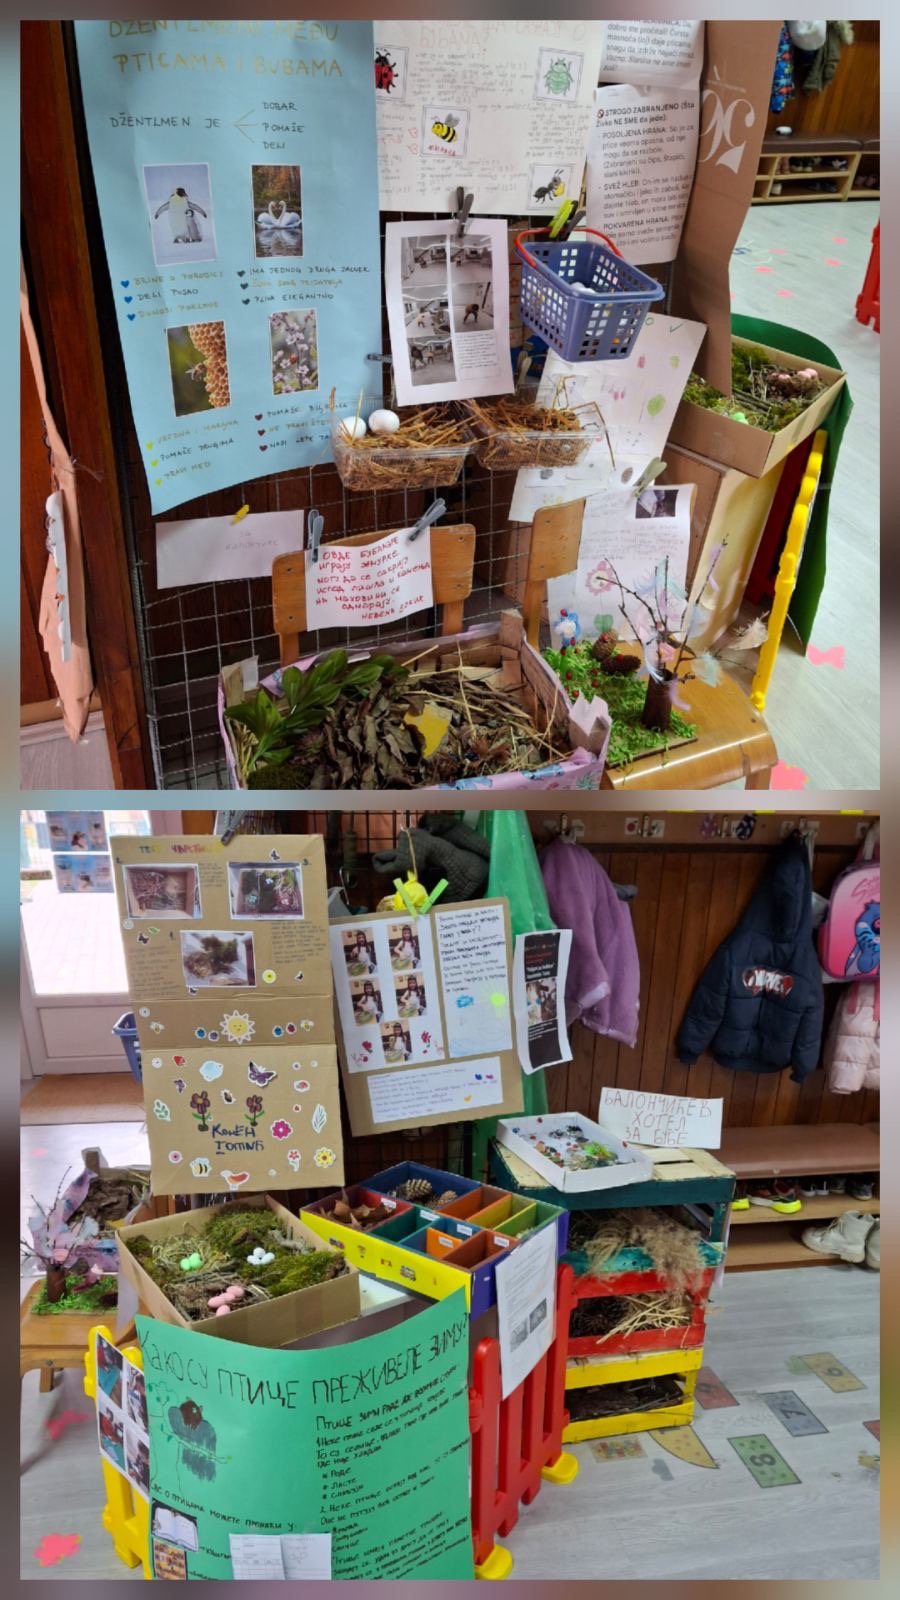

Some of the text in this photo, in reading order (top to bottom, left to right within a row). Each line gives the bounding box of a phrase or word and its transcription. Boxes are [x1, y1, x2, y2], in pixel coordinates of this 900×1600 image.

[112, 52, 226, 74] PTICAMA
[255, 56, 343, 78] BUBAMA
[262, 101, 299, 113] DOBAR
[605, 102, 680, 117] STROGO ZABRANJENO
[110, 112, 221, 129] DŽENTLMEN JE
[262, 140, 286, 151] DELI
[603, 218, 644, 230] POKVARENA
[322, 550, 351, 561] ОВДЕ
[604, 1090, 712, 1118] БАЛОНЧИЋЕВ
[632, 1110, 686, 1132] ХОТЕЛ
[624, 1127, 688, 1145] ЗА БУБЕ
[217, 1368, 300, 1410] ПТИЦЕ
[312, 1343, 422, 1405] ПРЕЖИВЕЛЕ
[749, 1452, 776, 1467] 8
